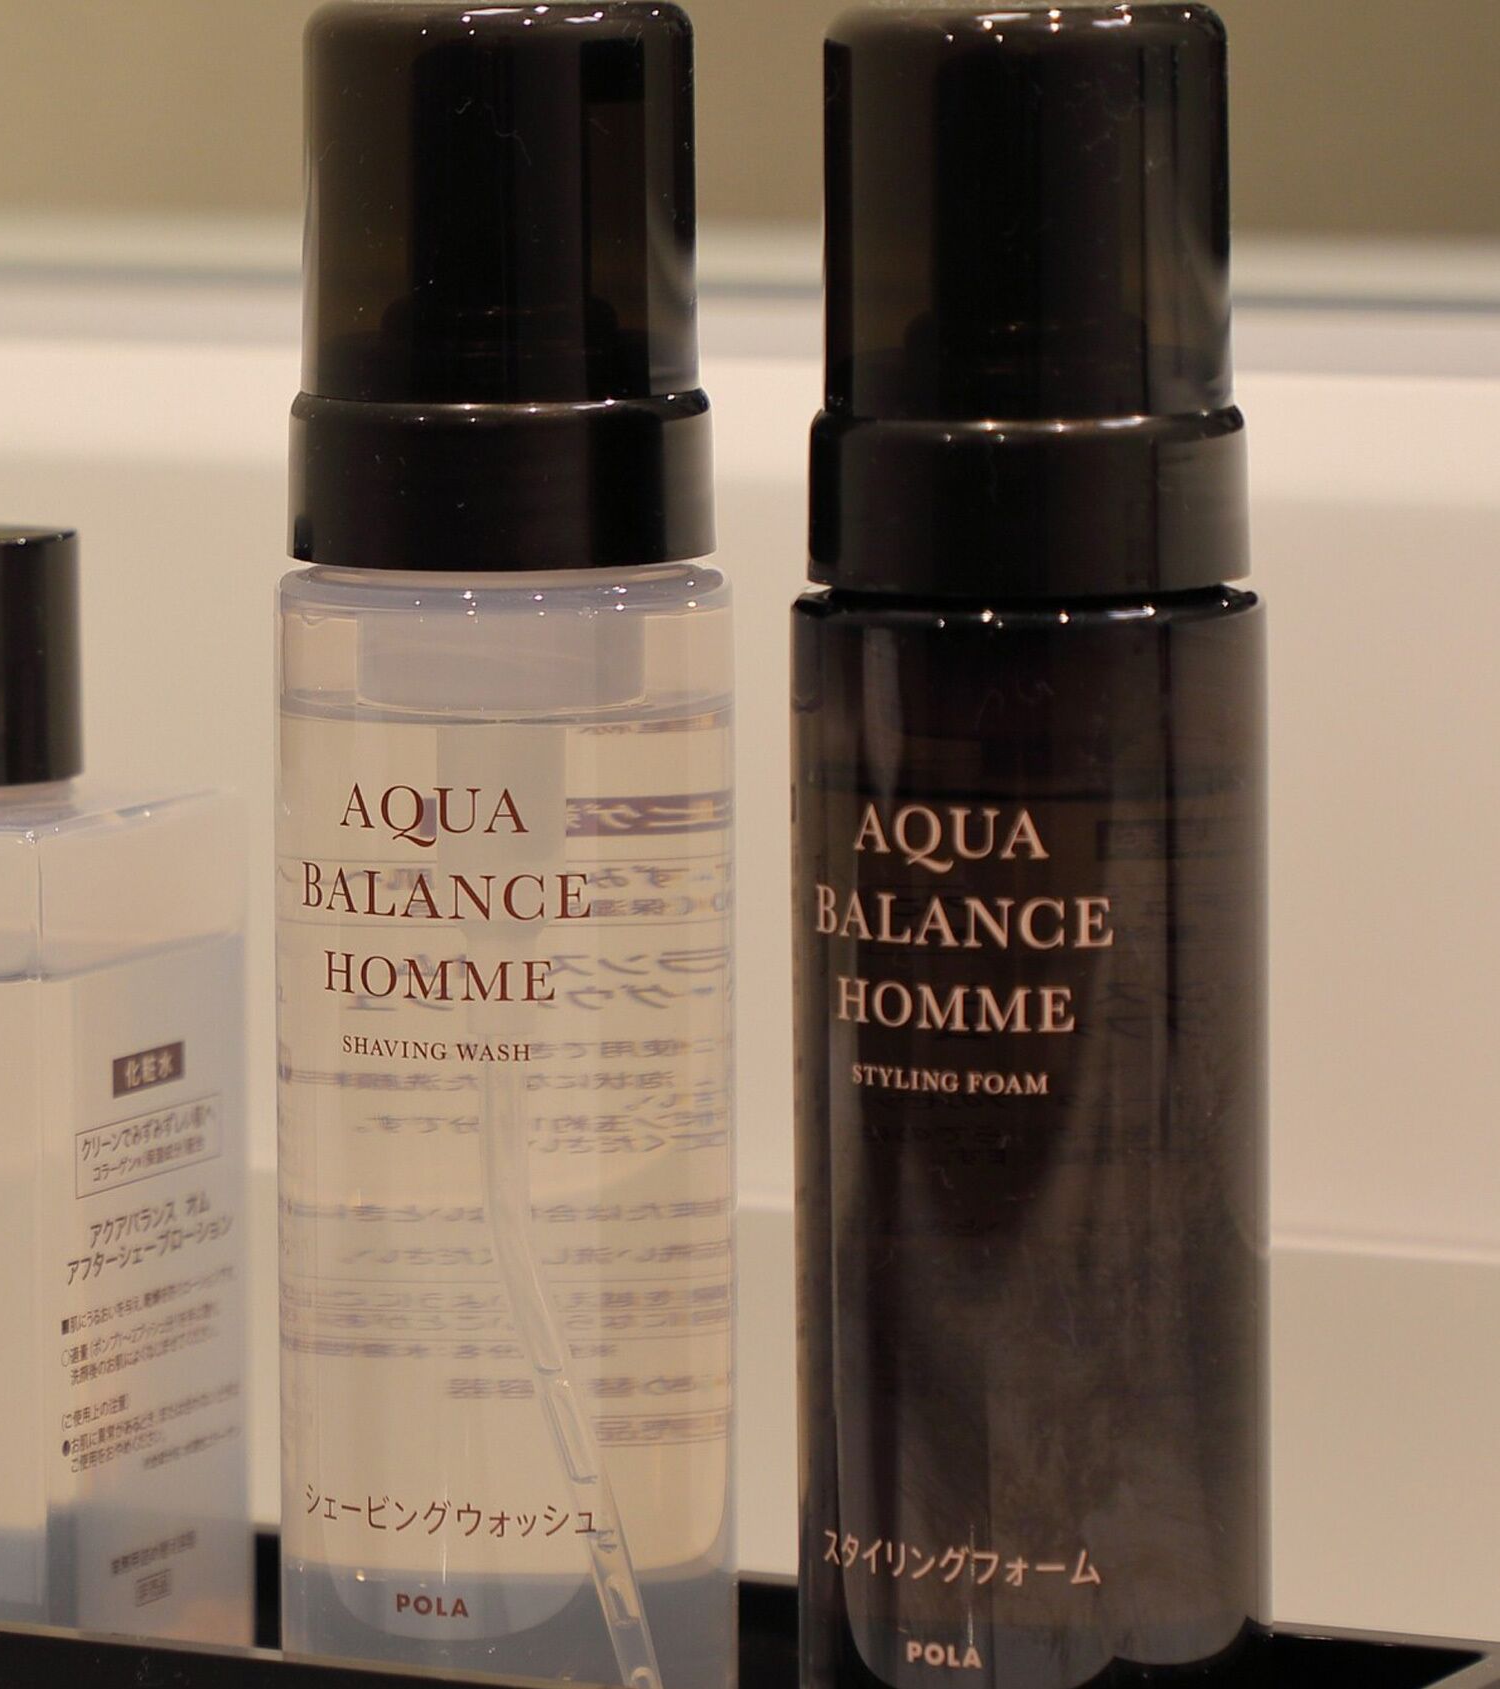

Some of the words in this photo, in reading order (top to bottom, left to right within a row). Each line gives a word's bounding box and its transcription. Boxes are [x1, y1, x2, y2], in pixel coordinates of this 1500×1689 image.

[340, 783, 529, 847] AQUA
[854, 802, 1050, 873] AQUA
[302, 861, 591, 920] BALANCE
[816, 884, 1114, 949] BALANCE
[324, 950, 555, 1002] HOMME
[837, 976, 1075, 1033] HOMME
[343, 1035, 447, 1060] SHAVING
[456, 1043, 531, 1062] WASH
[852, 1064, 959, 1093] STYLING
[967, 1072, 1049, 1095] FOAM
[90, 1202, 175, 1249] アクアバランス
[306, 1485, 598, 1538] シェービングウォッシュ
[823, 1529, 1101, 1586] スタイリングフォーム
[395, 1593, 469, 1618] POLA
[906, 1641, 982, 1669] POLA
